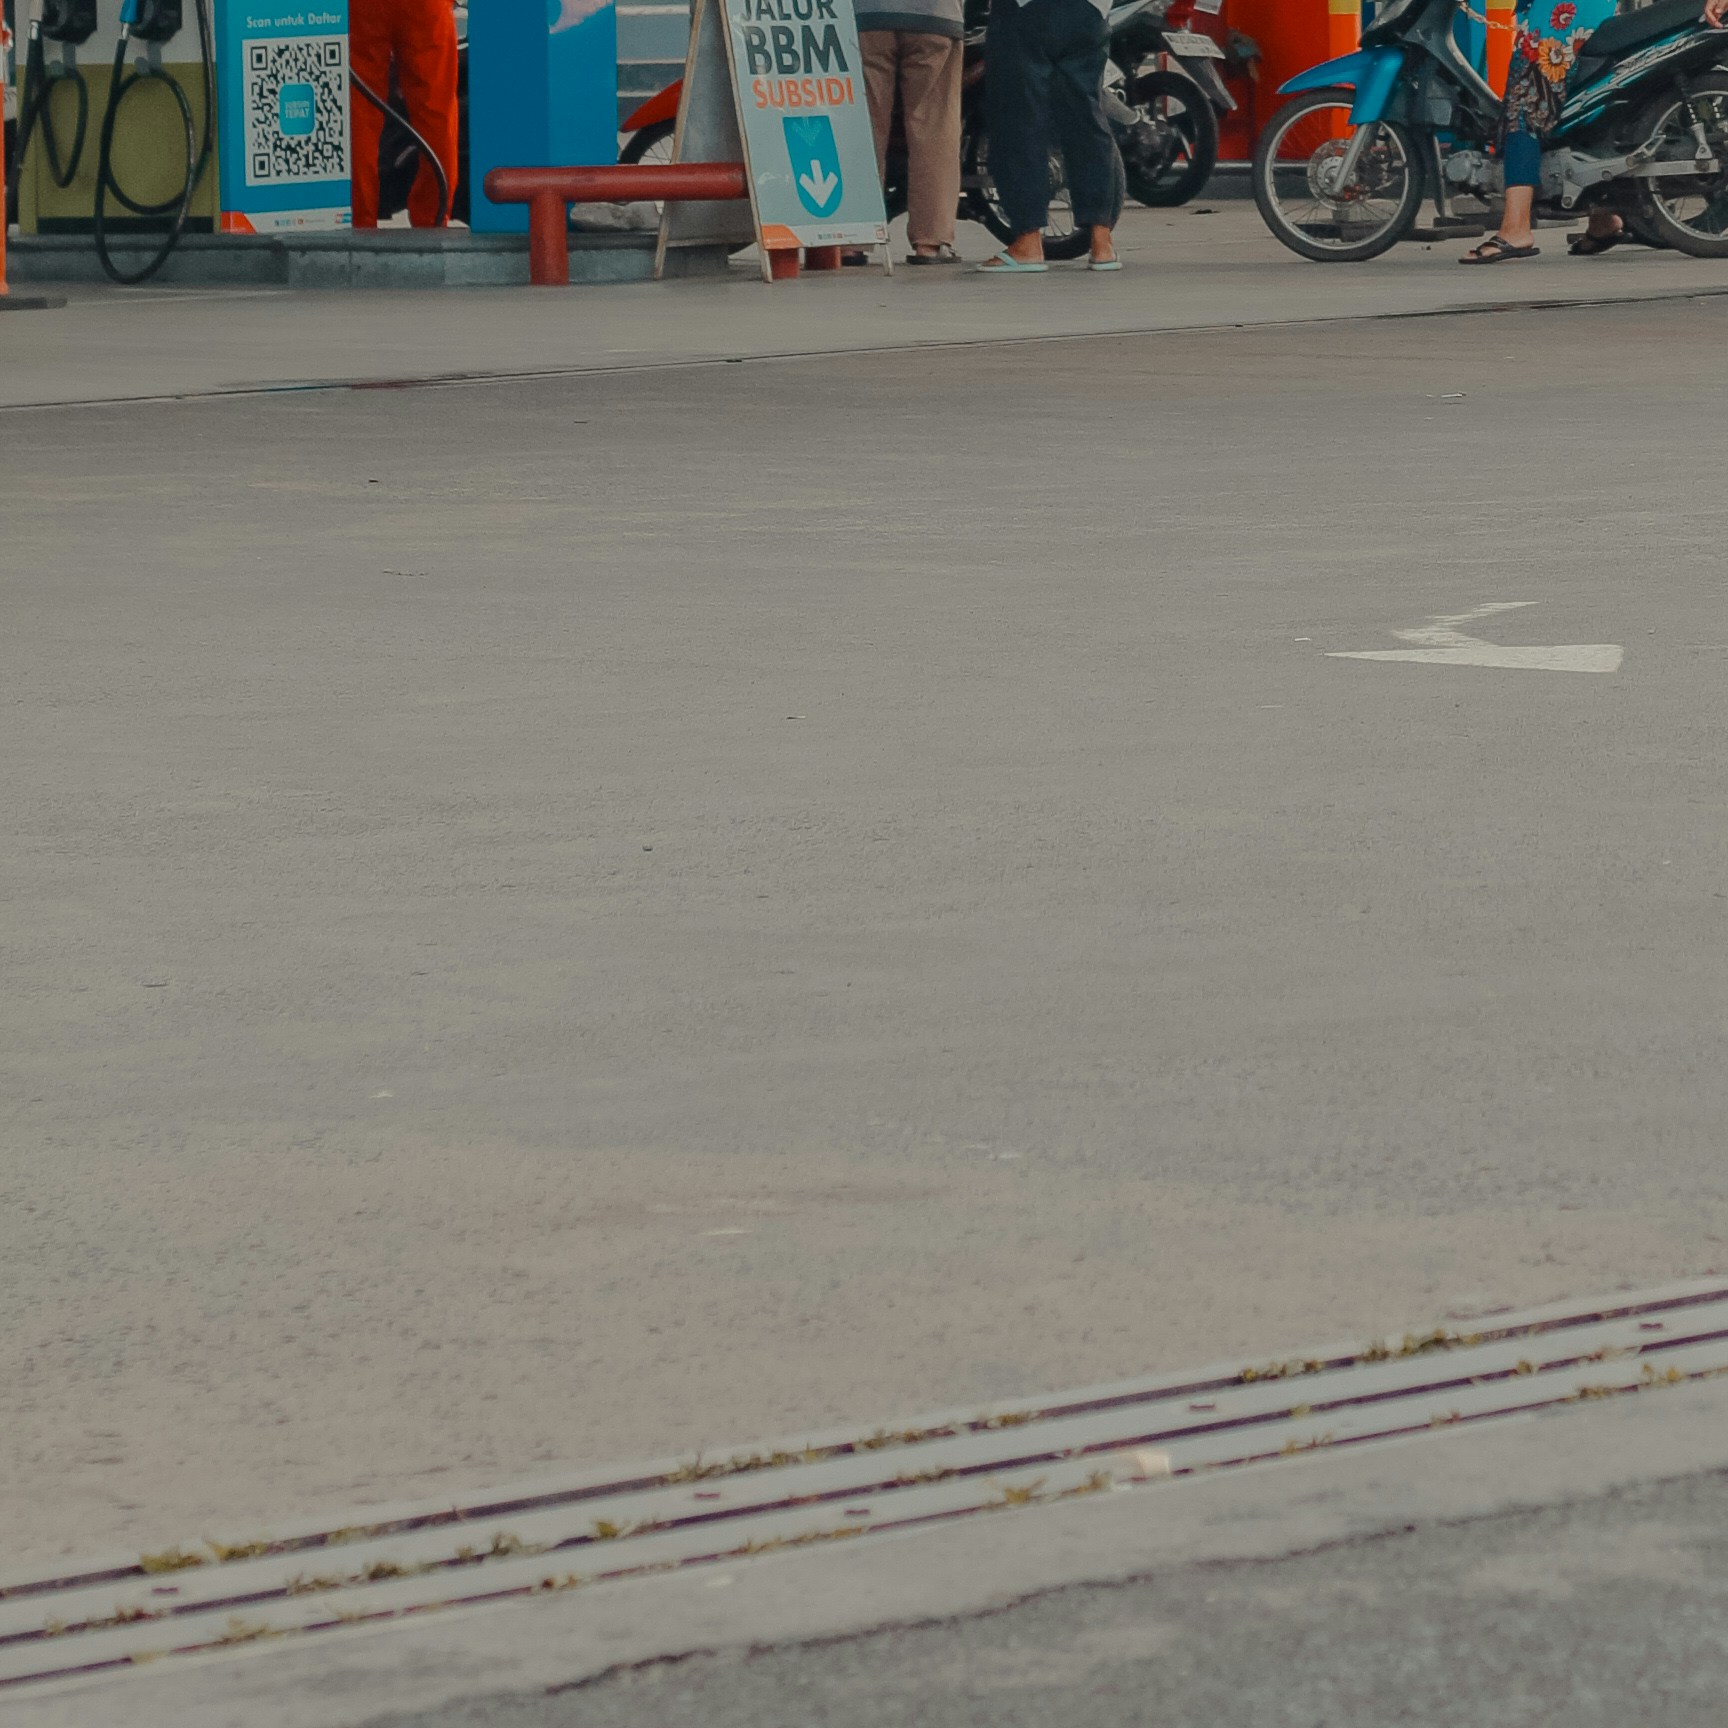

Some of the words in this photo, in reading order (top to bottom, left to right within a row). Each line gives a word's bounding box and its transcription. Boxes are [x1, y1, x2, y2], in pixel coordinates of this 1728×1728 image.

[246, 15, 271, 28] Scan
[274, 13, 304, 27] untuk
[307, 12, 342, 25] Daftar
[743, 24, 849, 75] BBM
[752, 77, 855, 110] SUBSIDI
